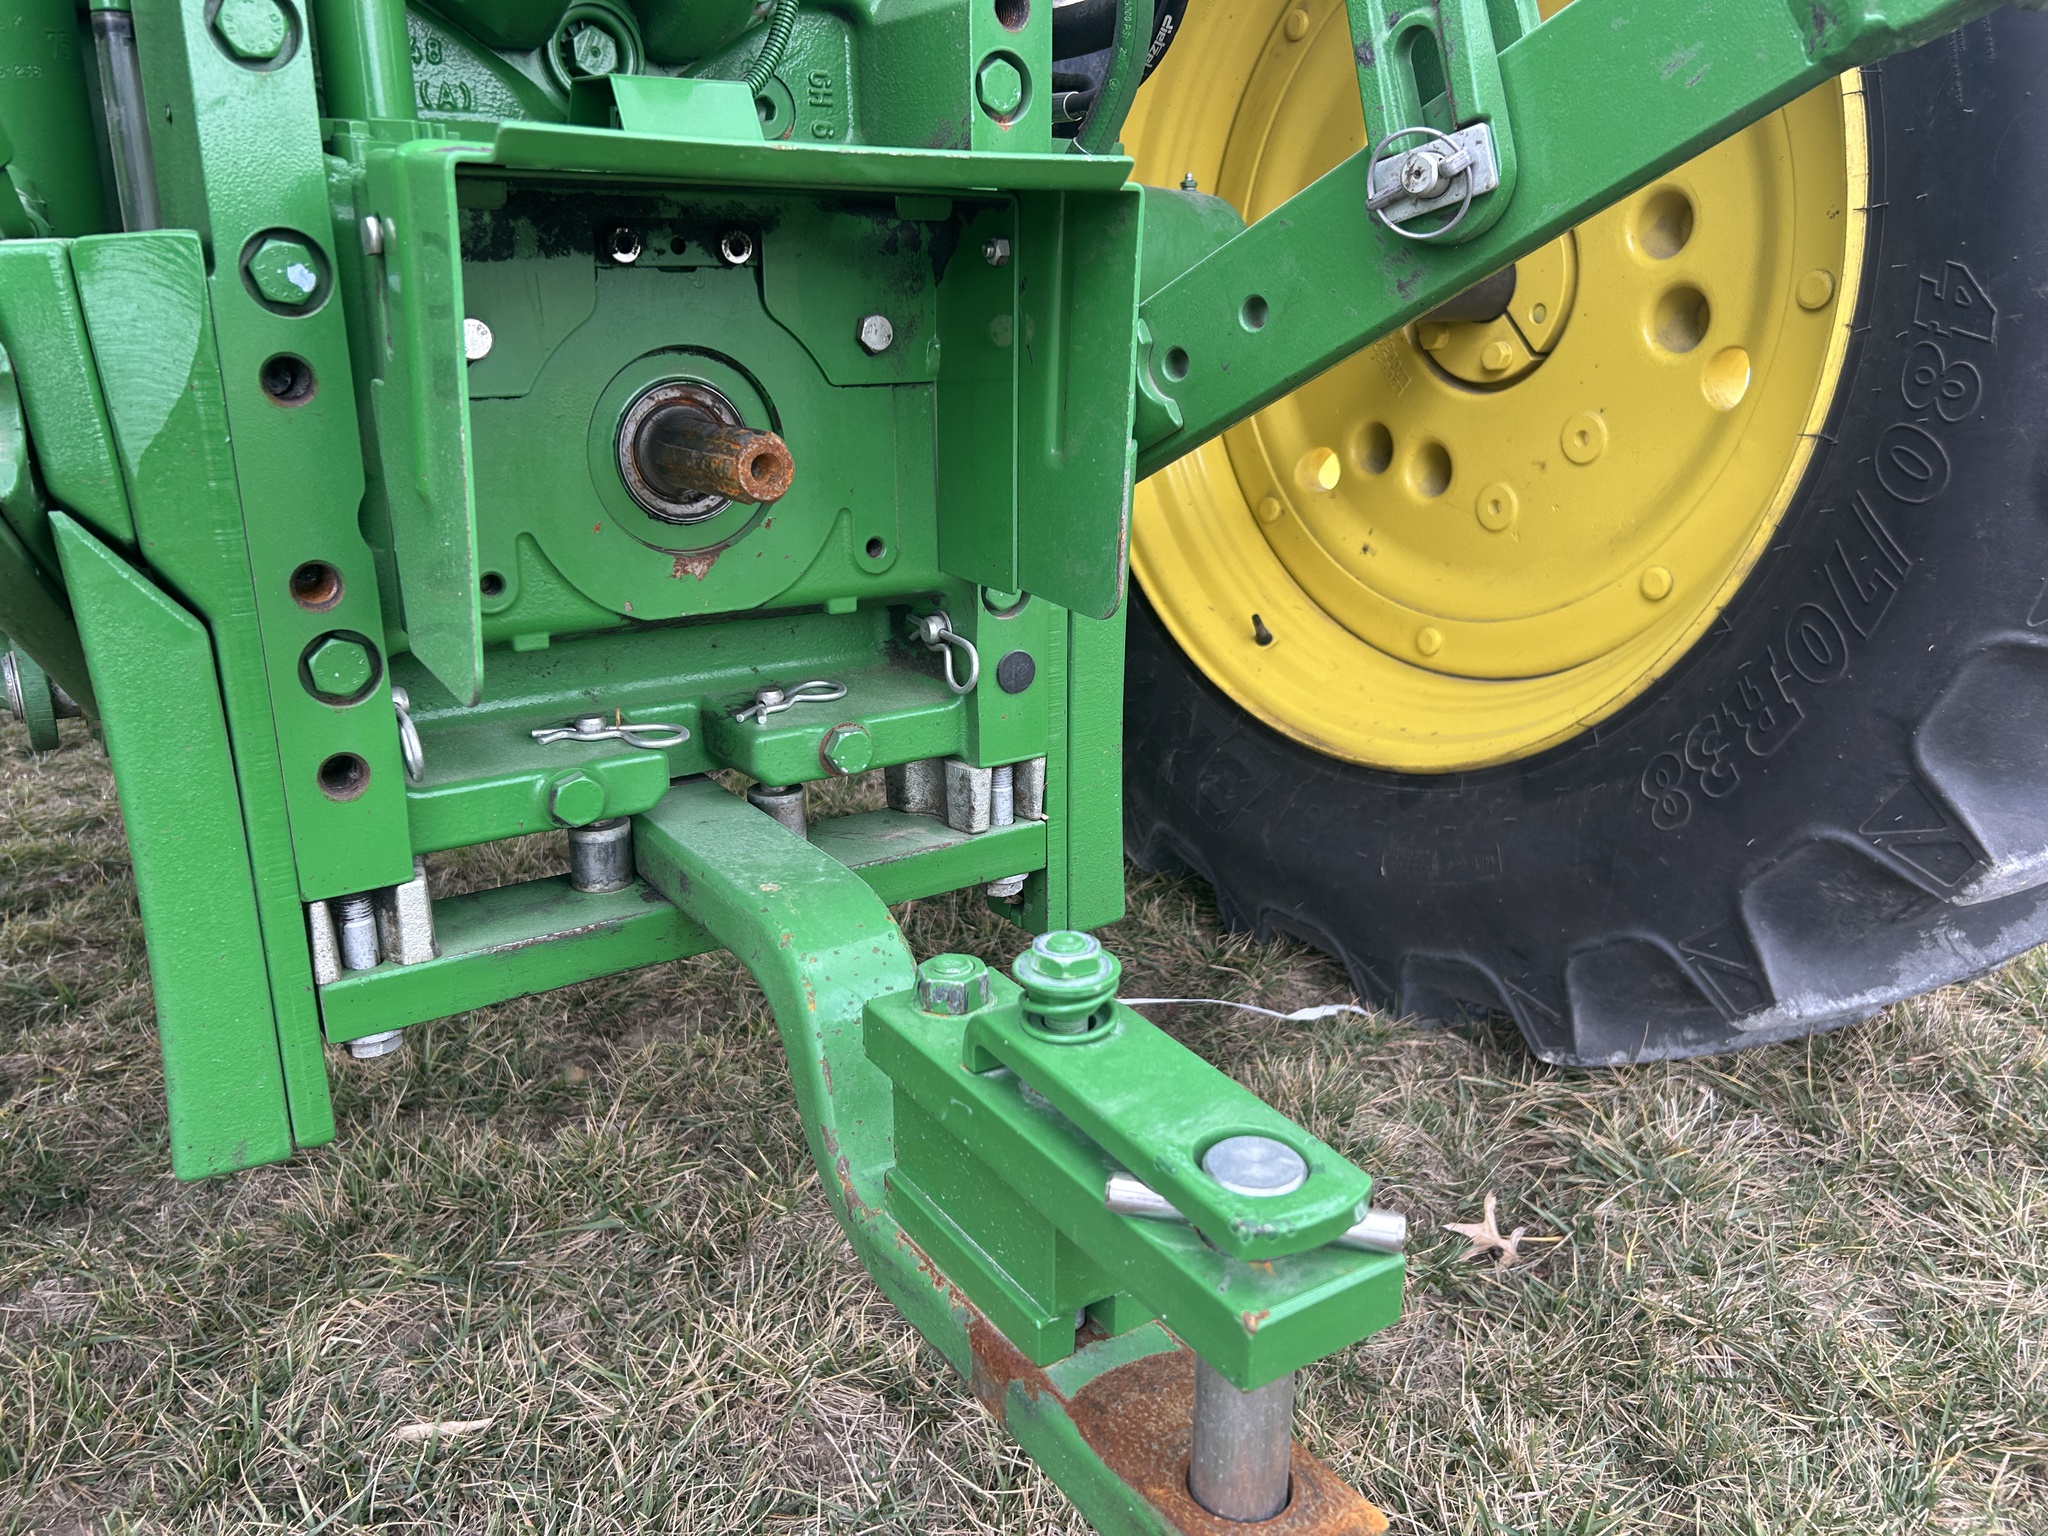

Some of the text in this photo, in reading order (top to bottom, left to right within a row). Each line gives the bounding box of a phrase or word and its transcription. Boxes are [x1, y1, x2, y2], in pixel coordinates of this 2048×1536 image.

[1145, 14, 1174, 68] dietzel
[419, 79, 472, 111] (A)
[807, 69, 834, 108] GH
[1642, 260, 1997, 830] 480/70R38
